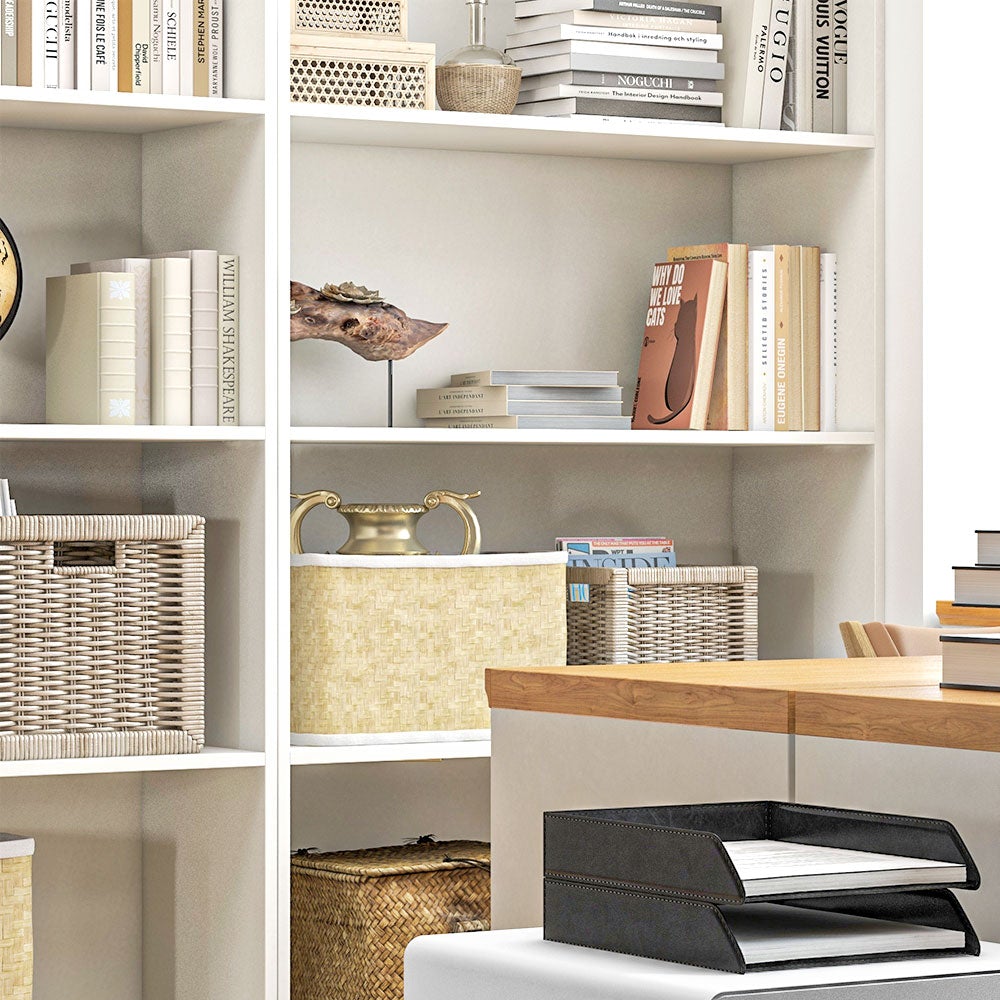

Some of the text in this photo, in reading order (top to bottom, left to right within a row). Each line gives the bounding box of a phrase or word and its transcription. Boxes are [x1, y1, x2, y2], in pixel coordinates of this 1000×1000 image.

[95, 14, 105, 32] FOIS
[95, 33, 105, 43] LE
[166, 12, 177, 61] SCHIELE
[211, 6, 219, 40] PROUST
[641, 33, 672, 42] inredning
[686, 36, 708, 44] styling
[834, 0, 847, 65] VOGUE
[95, 44, 107, 65] CAFÉ
[141, 43, 149, 64] David
[152, 24, 161, 63] Noguchi
[197, 21, 205, 64] STEPHEN
[757, 25, 768, 73] PALERMO
[769, 0, 790, 83] UGIO
[816, 0, 829, 100] UIS VUITTON
[134, 43, 142, 87] Chipperfield
[617, 74, 673, 89] NOGUCHI
[647, 92, 669, 100] Design
[652, 263, 686, 287] WHY DO
[650, 286, 683, 307] WE LOVE
[645, 307, 666, 327] CATS
[222, 259, 235, 423] WILLIAM SHAKESPEARE
[777, 338, 786, 425] EUGENE ONEGIN
